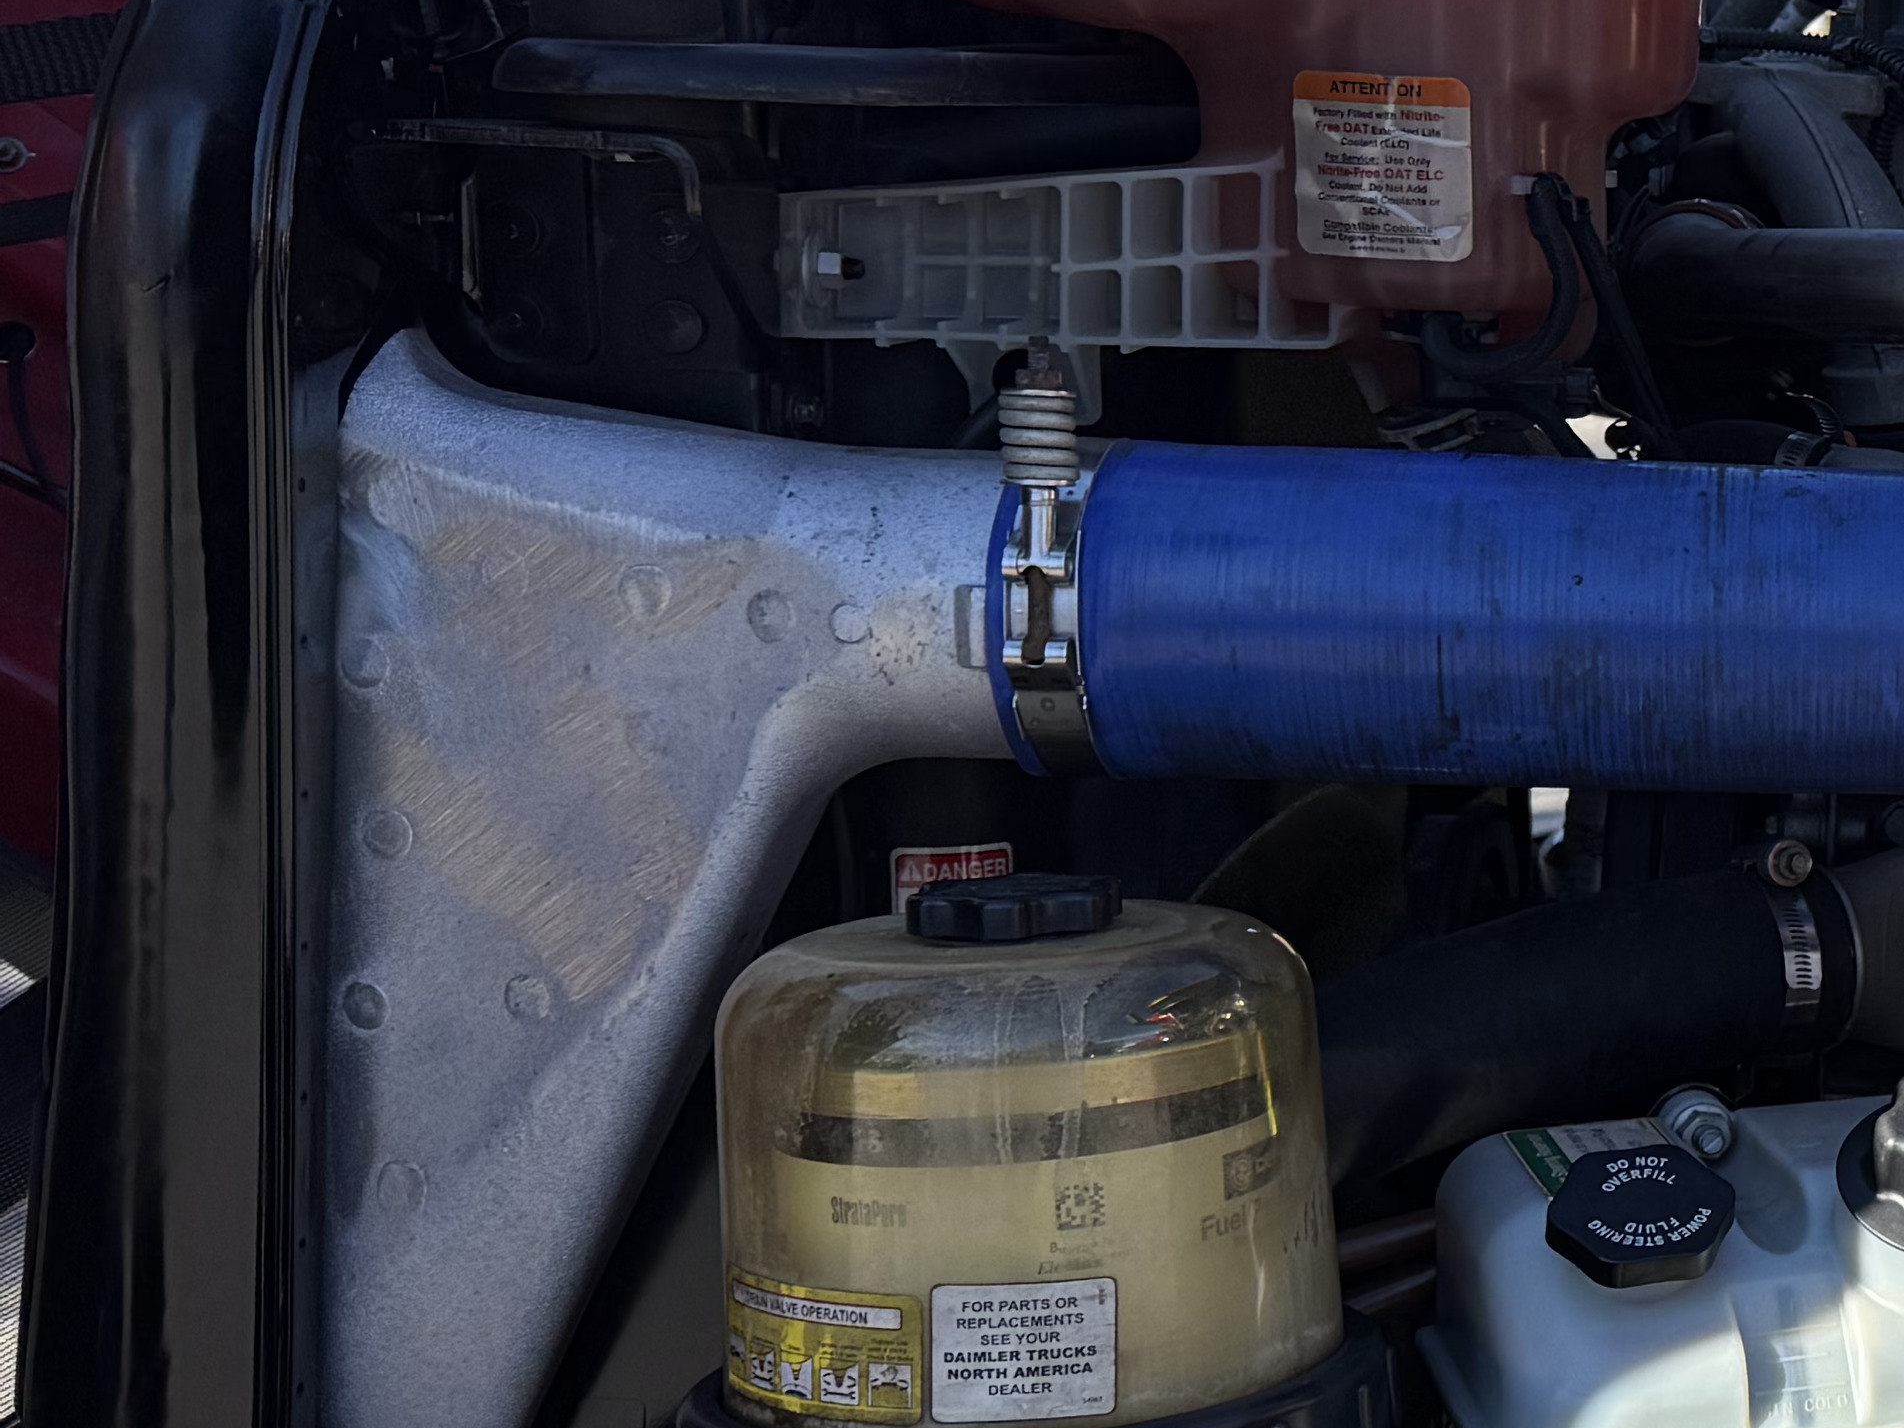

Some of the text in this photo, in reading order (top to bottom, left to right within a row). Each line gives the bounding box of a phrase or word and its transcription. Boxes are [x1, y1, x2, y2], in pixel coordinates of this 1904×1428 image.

[1330, 80, 1422, 98] ATTENTON
[1313, 107, 1345, 119] Factory
[1347, 109, 1373, 118] Filled
[1315, 121, 1341, 132] Free
[1342, 123, 1369, 134] OAT
[1385, 155, 1404, 165] Use
[1384, 168, 1412, 180] OAT
[1416, 170, 1444, 181] ELC
[1369, 183, 1382, 192] Do
[1385, 183, 1403, 192] Not
[1406, 183, 1427, 193] Add
[922, 858, 1007, 882] DANGER
[1606, 1156, 1669, 1173] DO NOT
[1601, 1169, 1676, 1192] OVERFILL
[1588, 1207, 1712, 1247] POWER STEERING
[1624, 1217, 1680, 1233] FLUID
[962, 1297, 1078, 1313] FOR PARTS OR
[801, 1305, 867, 1324] OPERATION
[956, 1312, 1084, 1329] REPLACEMENTS
[980, 1331, 1060, 1346] SEE YOUR
[943, 1345, 1097, 1363] DAIMLER TRUCKS
[947, 1362, 1093, 1380] NORTH AMERICA
[988, 1382, 1052, 1396] DEALER
